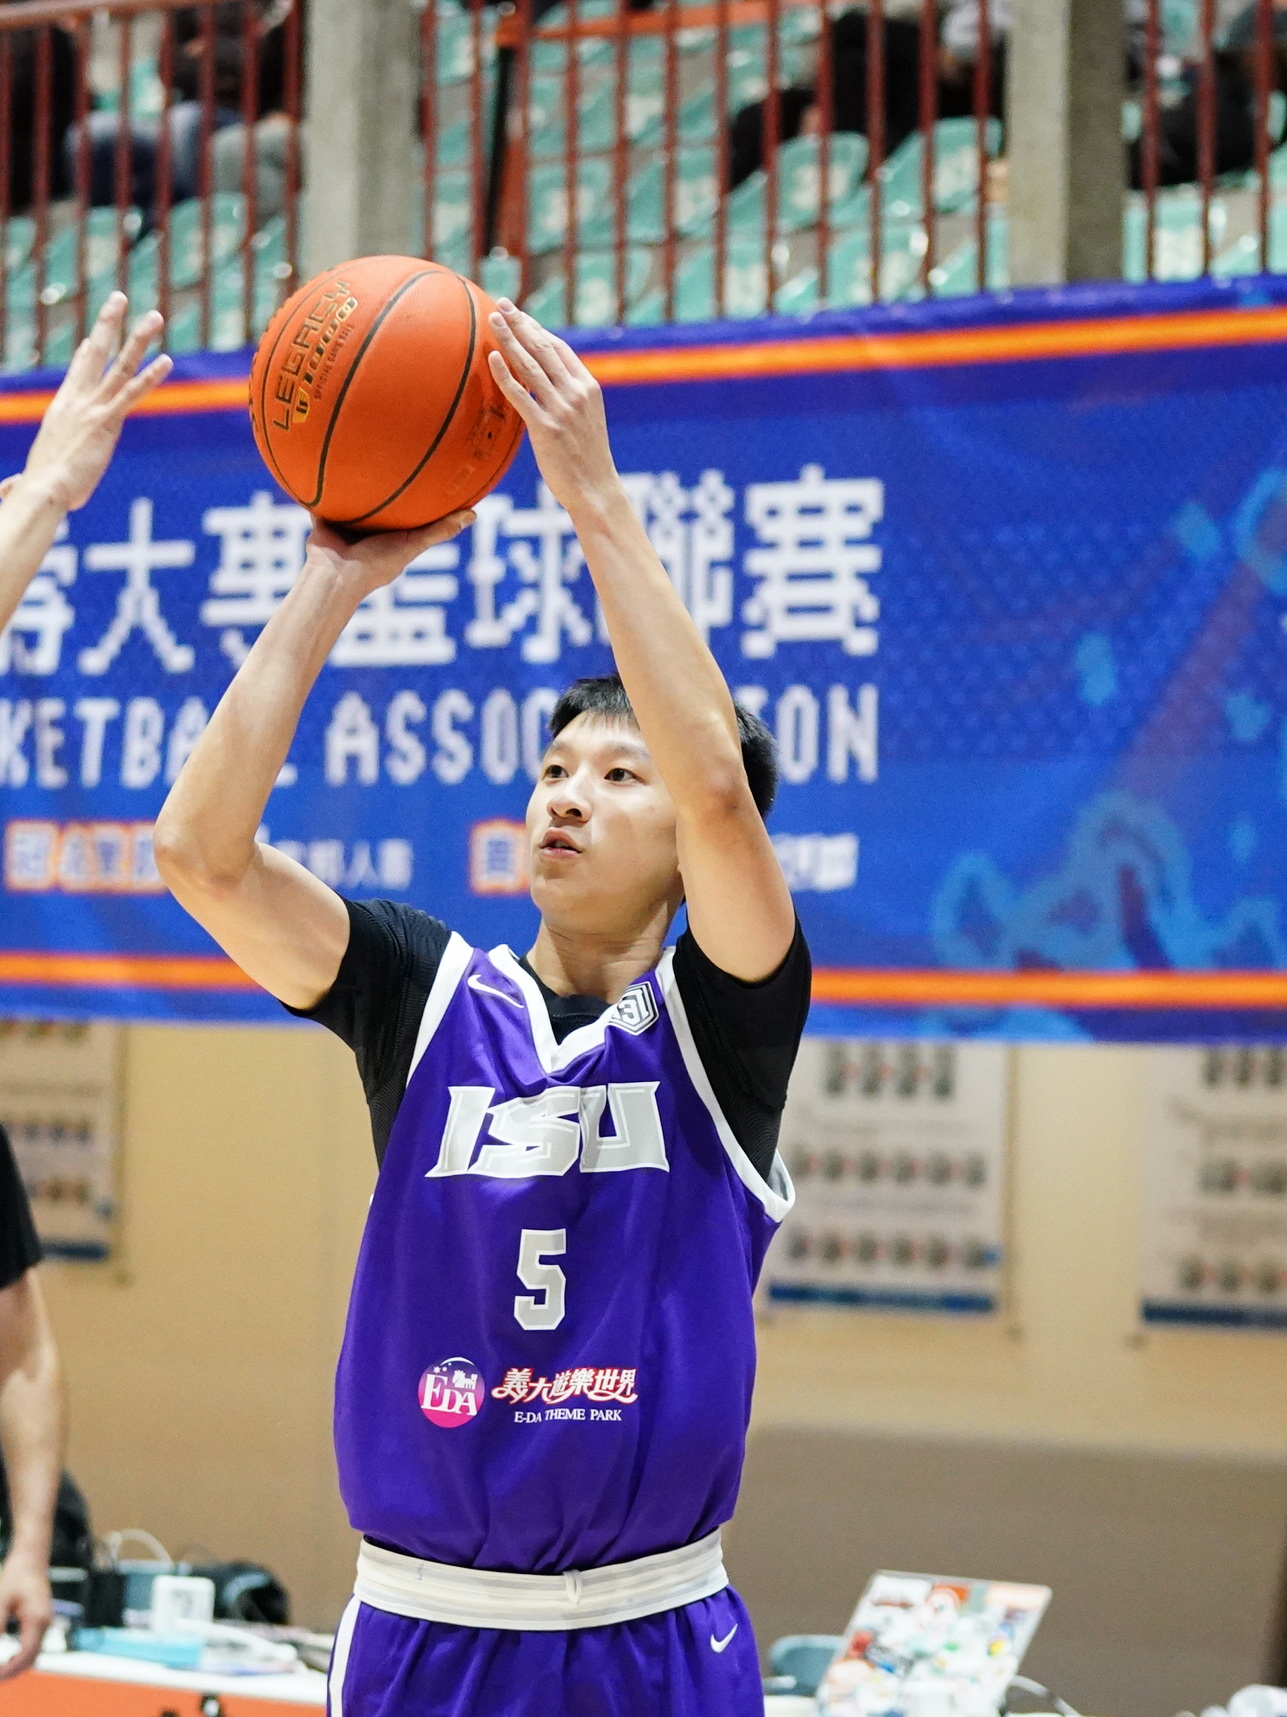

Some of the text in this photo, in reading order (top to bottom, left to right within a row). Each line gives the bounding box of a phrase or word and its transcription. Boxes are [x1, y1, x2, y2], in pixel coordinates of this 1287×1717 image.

[272, 280, 350, 432] LEGACY
[424, 1081, 670, 1178] ISU
[513, 1228, 566, 1331] 5
[420, 1373, 478, 1416] EDA
[491, 1368, 639, 1405] 義大遊樂世界
[514, 1408, 623, 1424] E-DA THEME PARK
